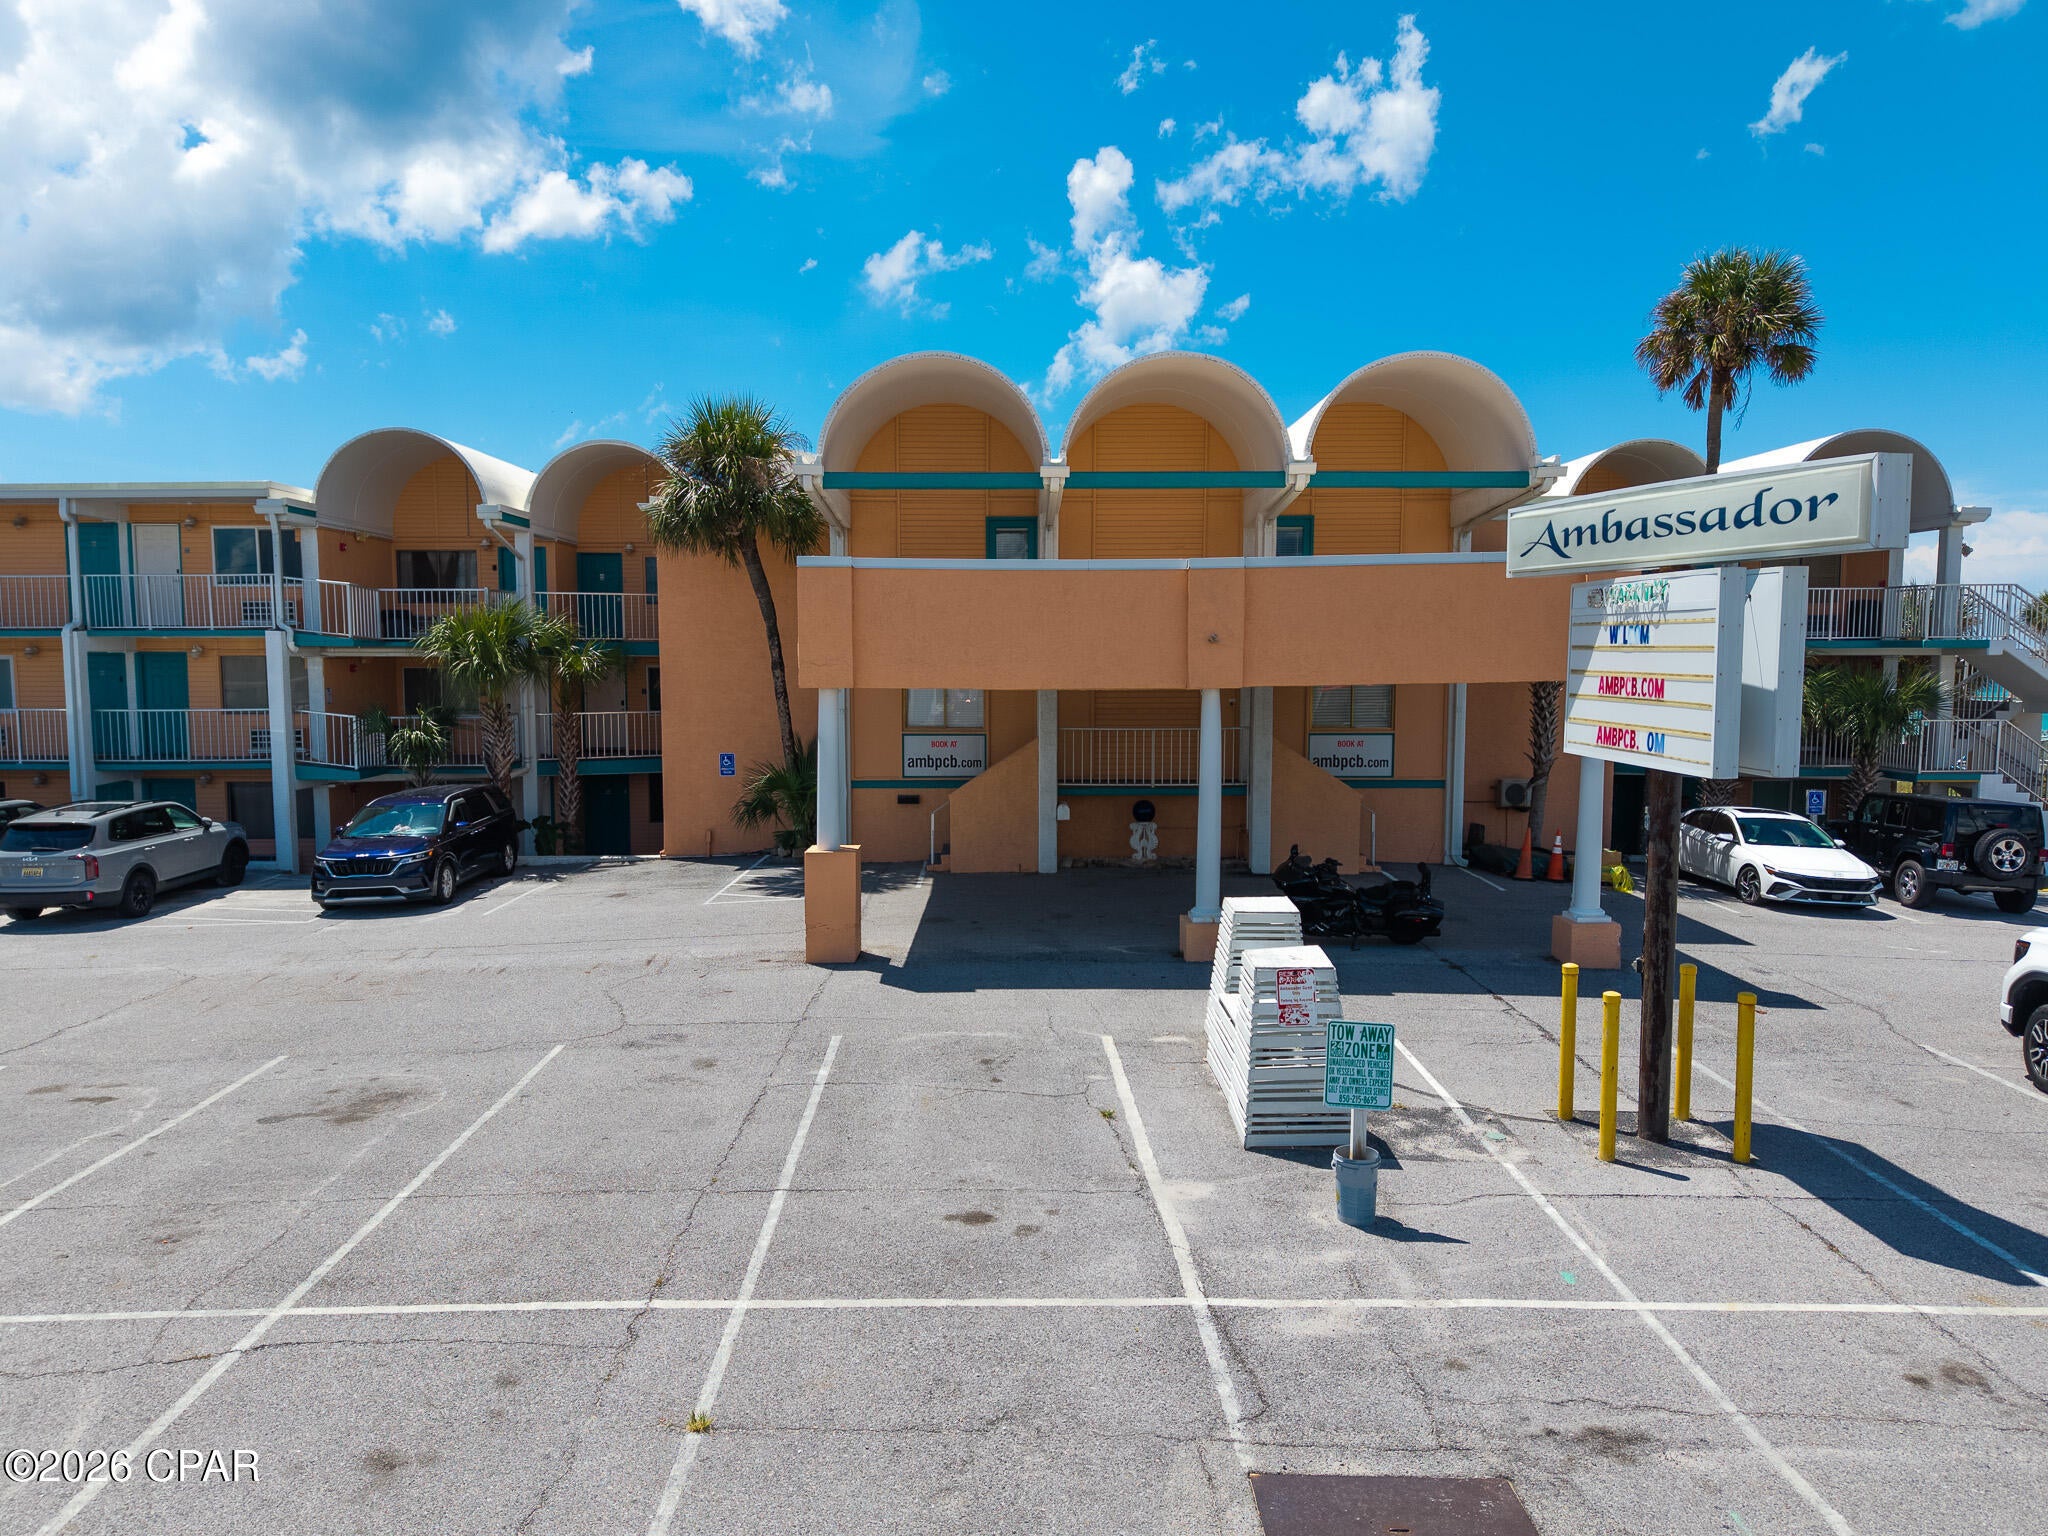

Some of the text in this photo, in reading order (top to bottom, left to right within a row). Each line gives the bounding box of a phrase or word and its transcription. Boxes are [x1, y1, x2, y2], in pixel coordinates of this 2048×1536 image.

[1519, 486, 1839, 559] Ambassador
[1598, 675, 1665, 699] AMBPCB.COM
[931, 740, 958, 749] BOOK AT
[1337, 740, 1365, 748] BOOK AT
[907, 754, 982, 771] ambpcb.com
[1312, 754, 1389, 771] ambpcb.com
[1331, 1024, 1392, 1043] TOW AWAY
[1345, 1042, 1376, 1059] ZONE
[1329, 1058, 1390, 1069] UNAUTHORIZED VEHICLES
[1369, 1078, 1390, 1088] EXPENSE
